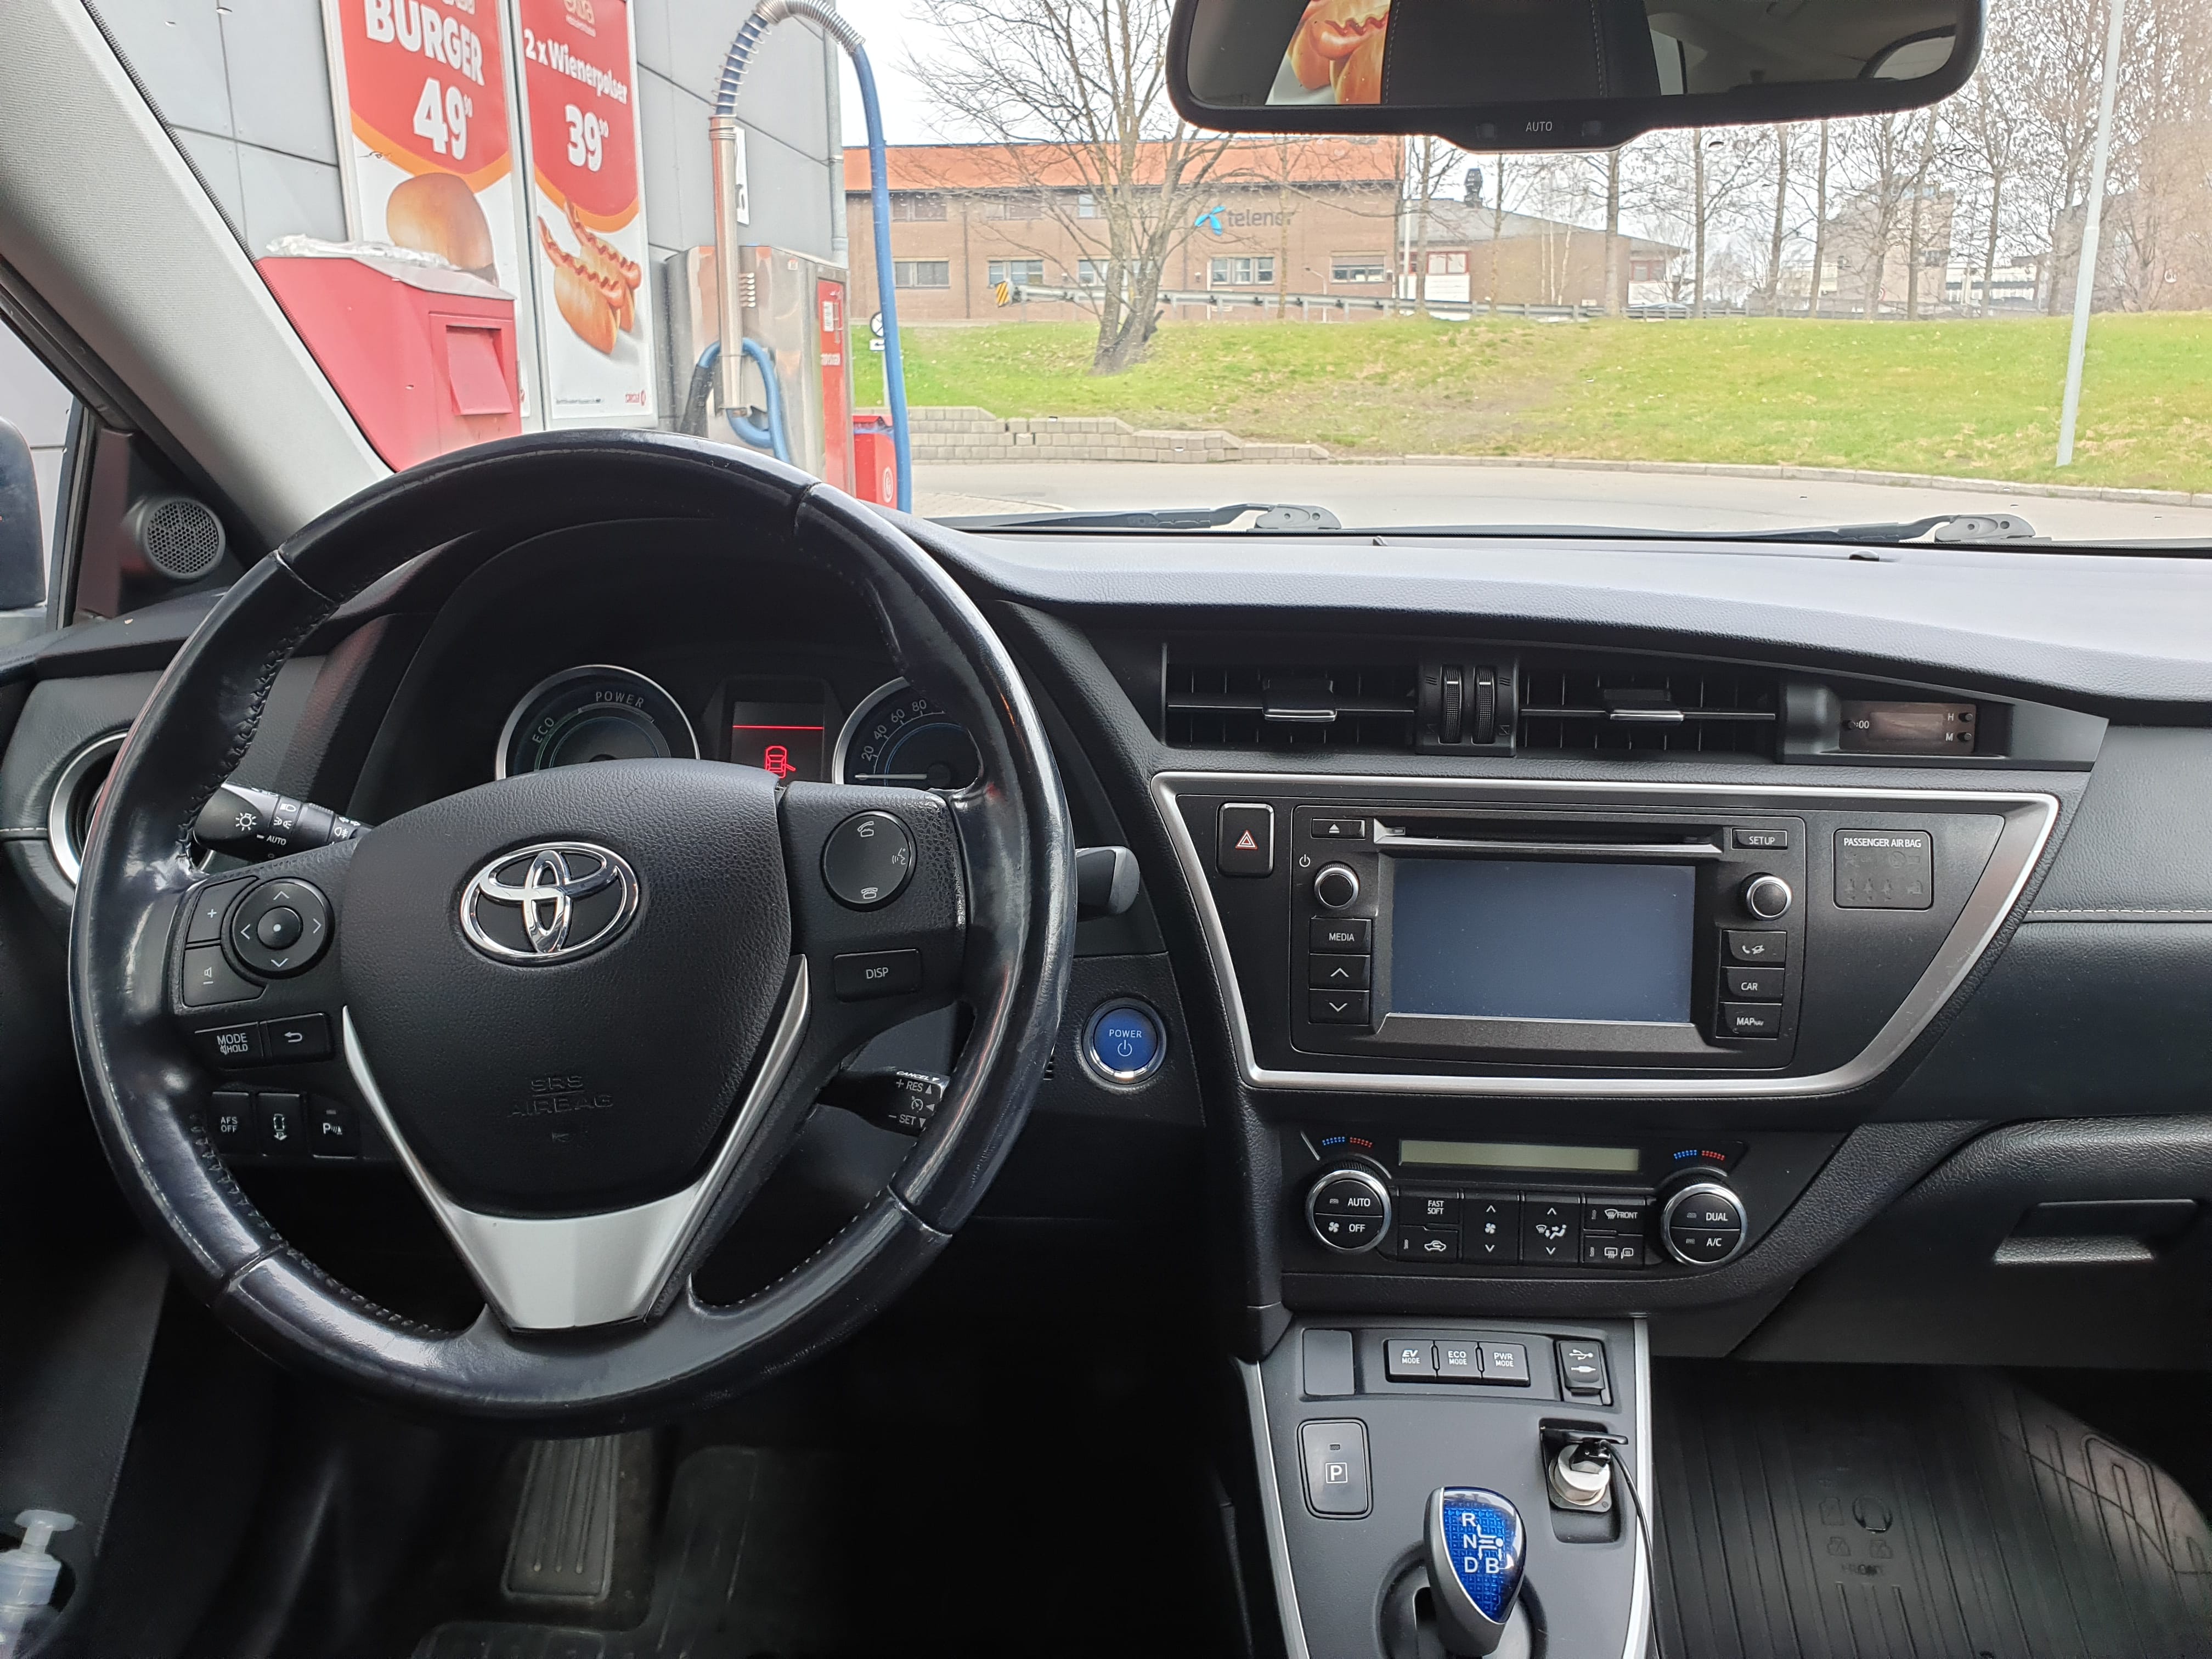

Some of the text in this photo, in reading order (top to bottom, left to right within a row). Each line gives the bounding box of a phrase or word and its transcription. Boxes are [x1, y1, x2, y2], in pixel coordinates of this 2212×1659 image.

[364, 0, 485, 86] BURGER
[523, 28, 537, 60] 2
[537, 40, 549, 66] x
[413, 77, 467, 160] 49
[1526, 122, 1553, 132] AUTO
[565, 104, 602, 172] 39
[596, 691, 644, 708] POWER
[912, 699, 927, 712] 80
[891, 709, 905, 723] 60
[1948, 713, 1954, 721] H
[532, 716, 555, 743] ECO
[874, 725, 887, 740] 40
[1945, 732, 1954, 741] M
[861, 746, 874, 761] 20
[267, 835, 286, 845] AUTO
[1844, 838, 1889, 847] PASSENGER
[1329, 932, 1355, 941] MEDIA
[866, 967, 889, 979] DISP
[1741, 982, 1758, 991] CAR
[217, 1033, 247, 1045] MODE
[1109, 1029, 1142, 1038] POWER
[226, 1044, 248, 1053] HOLD
[896, 1071, 929, 1080] CANCEL
[531, 1076, 584, 1091] SRS
[906, 1081, 924, 1092] RES
[507, 1095, 614, 1117] AIRBAG
[899, 1114, 917, 1125] SET
[1347, 1198, 1370, 1207] AUTO
[1617, 1211, 1638, 1219] FRONT
[1706, 1212, 1728, 1221] DUAL
[1348, 1223, 1365, 1232] OFF
[1706, 1238, 1722, 1247] A/C
[1330, 1465, 1342, 1481] P
[1462, 1513, 1476, 1527] R
[1463, 1534, 1477, 1549] N
[1464, 1557, 1499, 1573] D B
